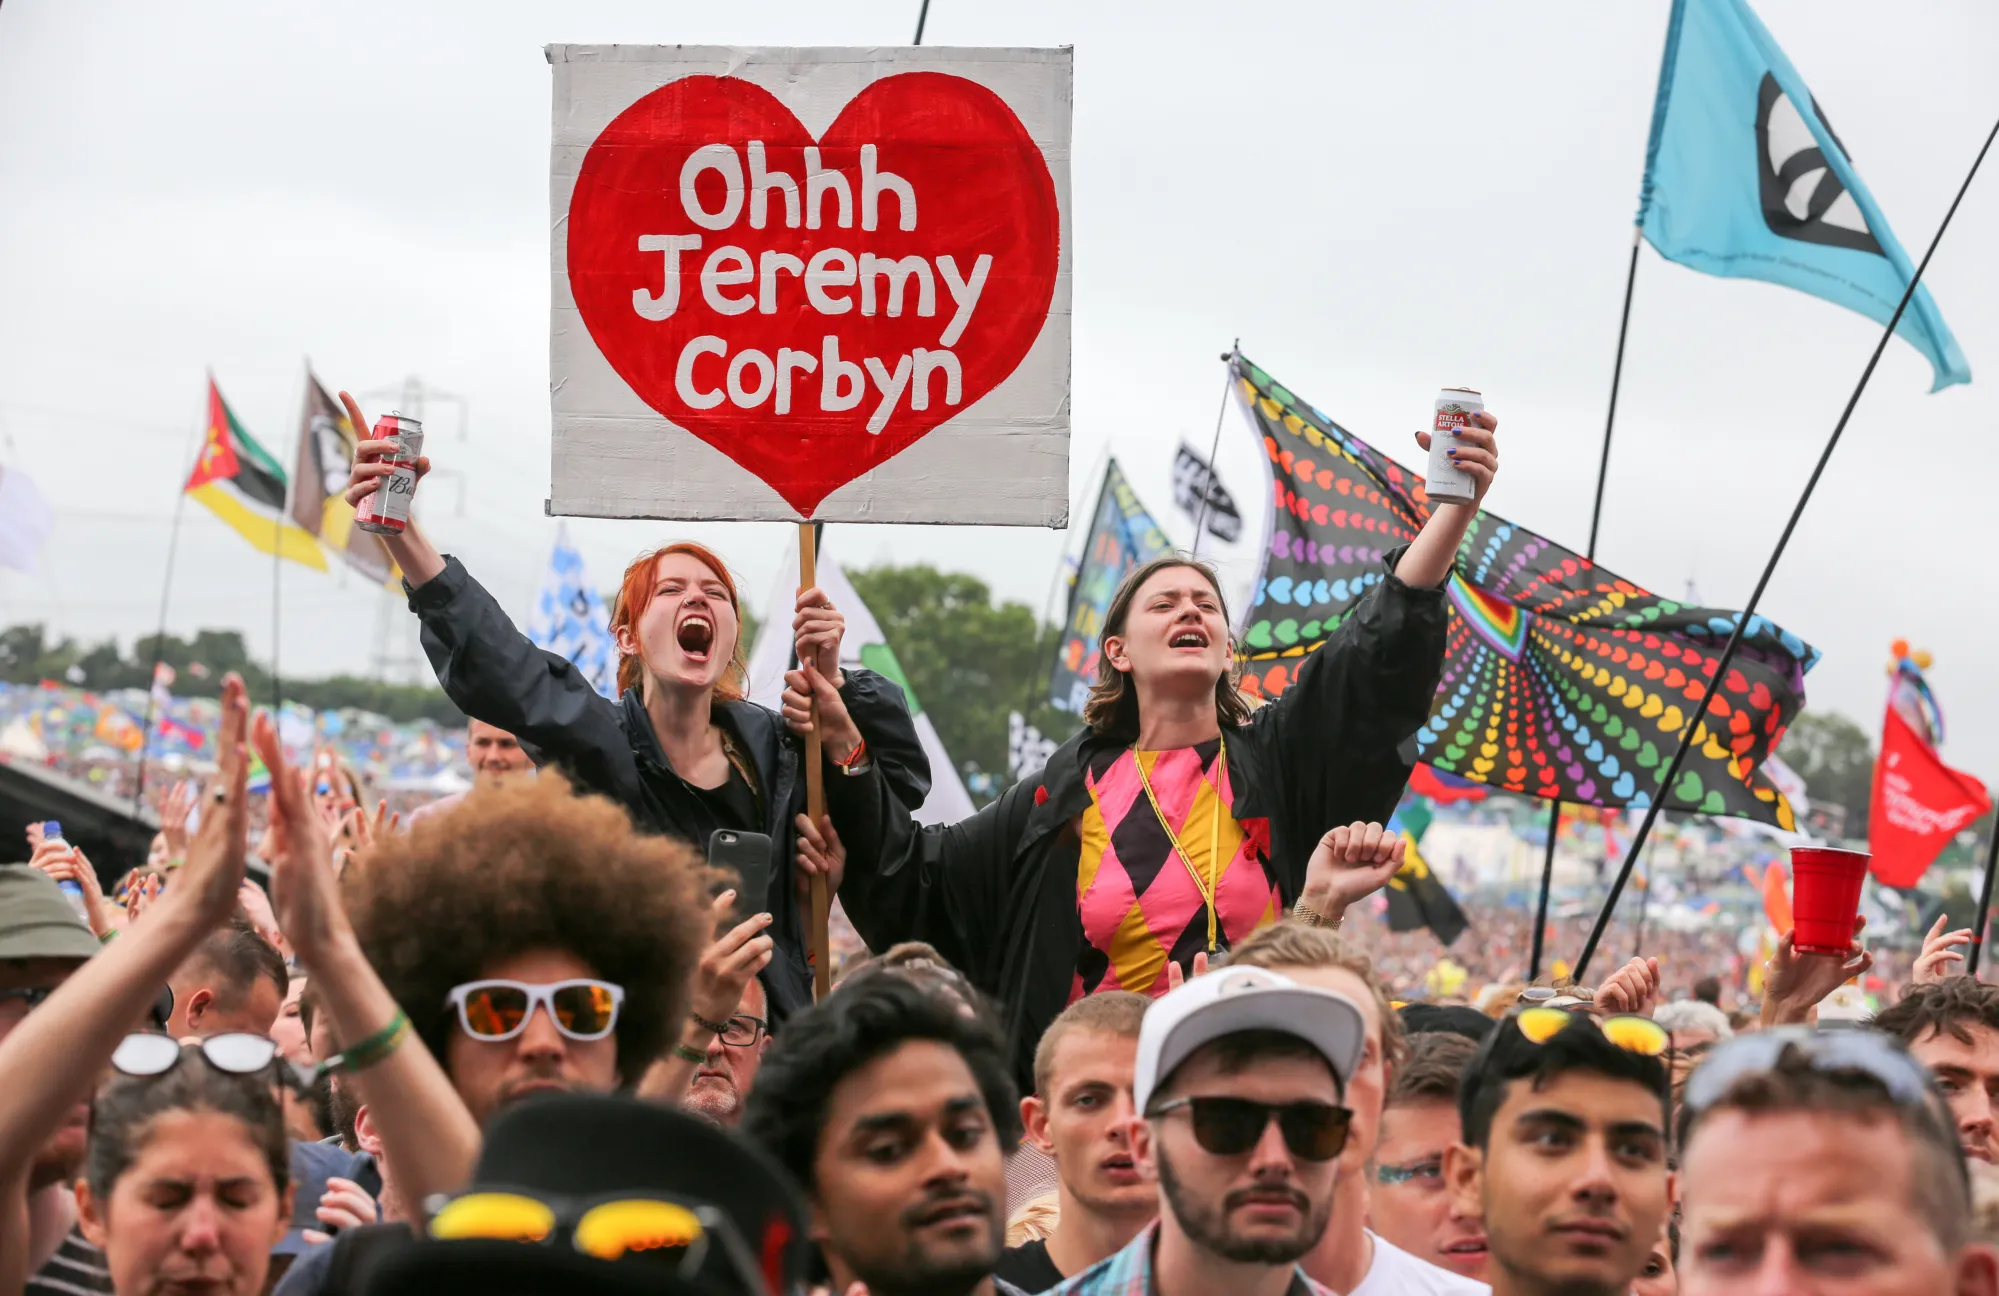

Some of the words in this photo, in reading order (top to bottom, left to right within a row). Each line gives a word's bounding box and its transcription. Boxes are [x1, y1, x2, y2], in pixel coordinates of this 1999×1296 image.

[679, 140, 917, 231] Ohhh
[632, 234, 993, 347] Jeremy
[675, 335, 963, 435] Corbyn
[1438, 414, 1464, 422] STELLA
